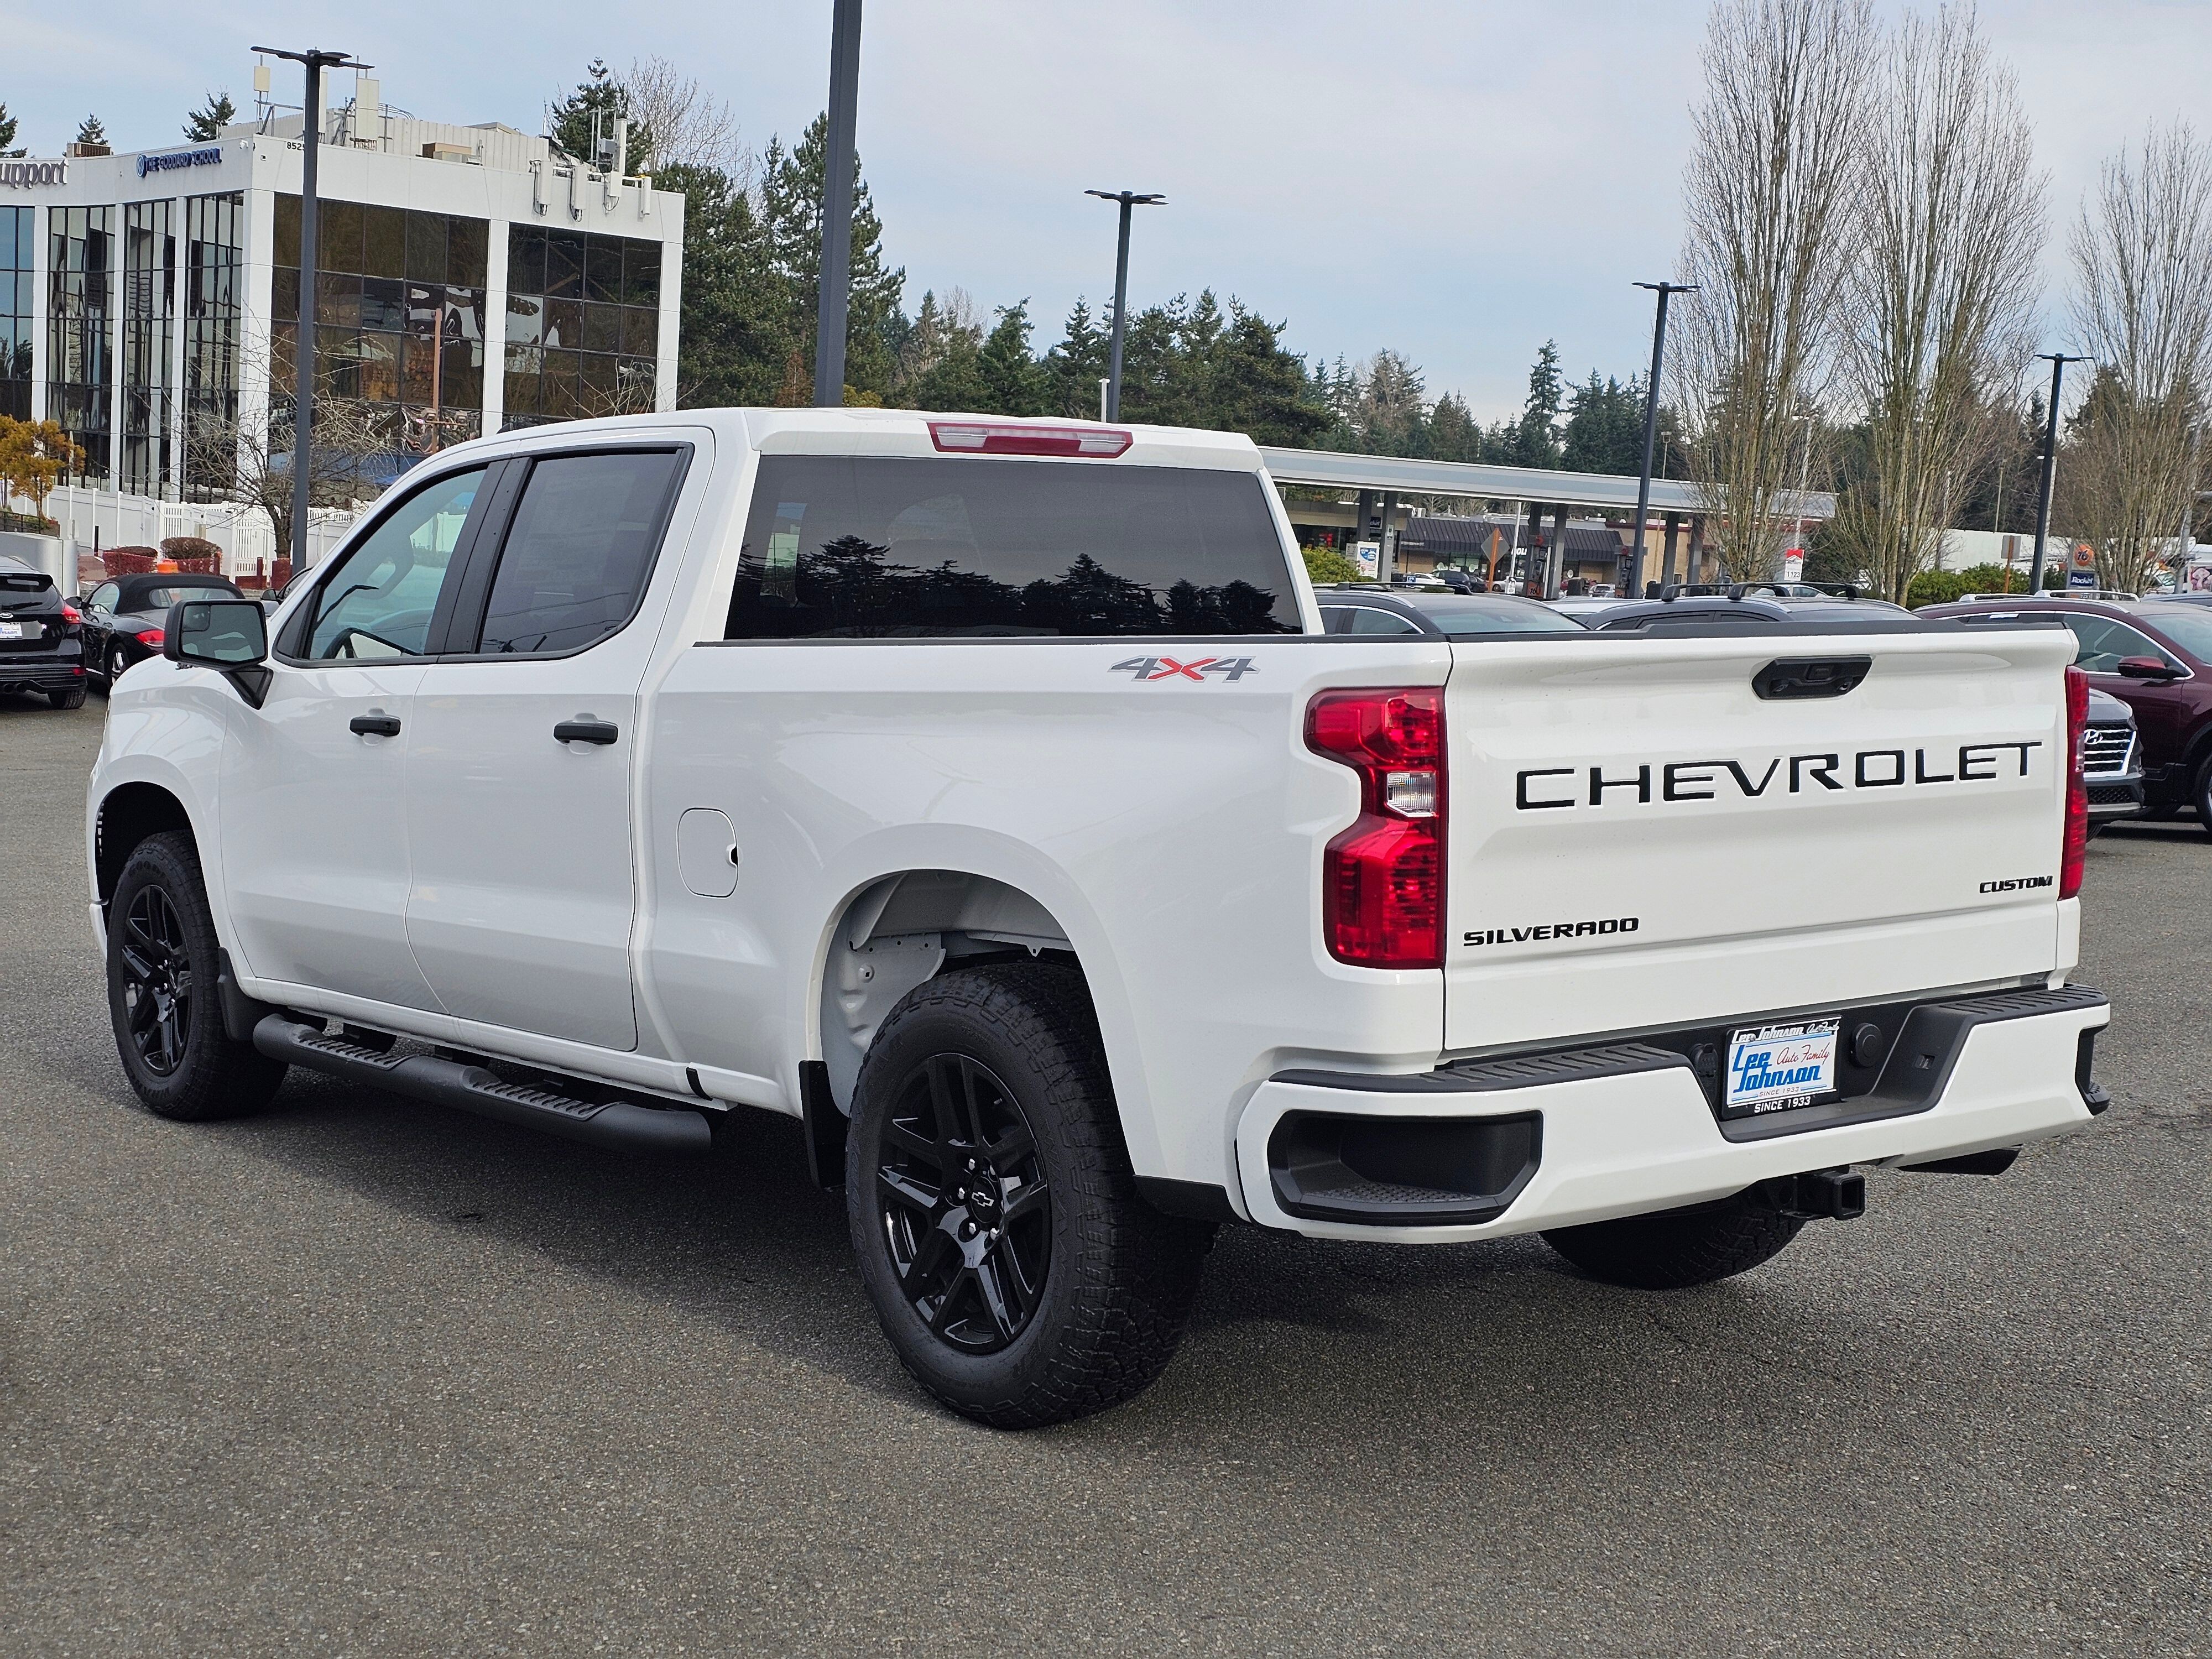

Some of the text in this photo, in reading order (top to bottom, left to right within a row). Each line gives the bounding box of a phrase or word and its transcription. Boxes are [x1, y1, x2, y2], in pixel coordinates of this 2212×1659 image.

[145, 148, 222, 171] THE GODDARD SCHOOL
[2077, 550, 2089, 561] 76
[1108, 655, 1260, 682] 4X4
[1516, 740, 2043, 810] CHEVROLET
[1979, 875, 2053, 894] CUSTOM
[1463, 917, 1639, 947] SILVERADO
[1755, 1025, 1804, 1041] Johnson
[1732, 1042, 1830, 1072] Lee Auto Family
[1733, 1065, 1822, 1093] Johnson
[1754, 1096, 1811, 1113] SINCE 1933
[1759, 1089, 1780, 1097] SINCE
